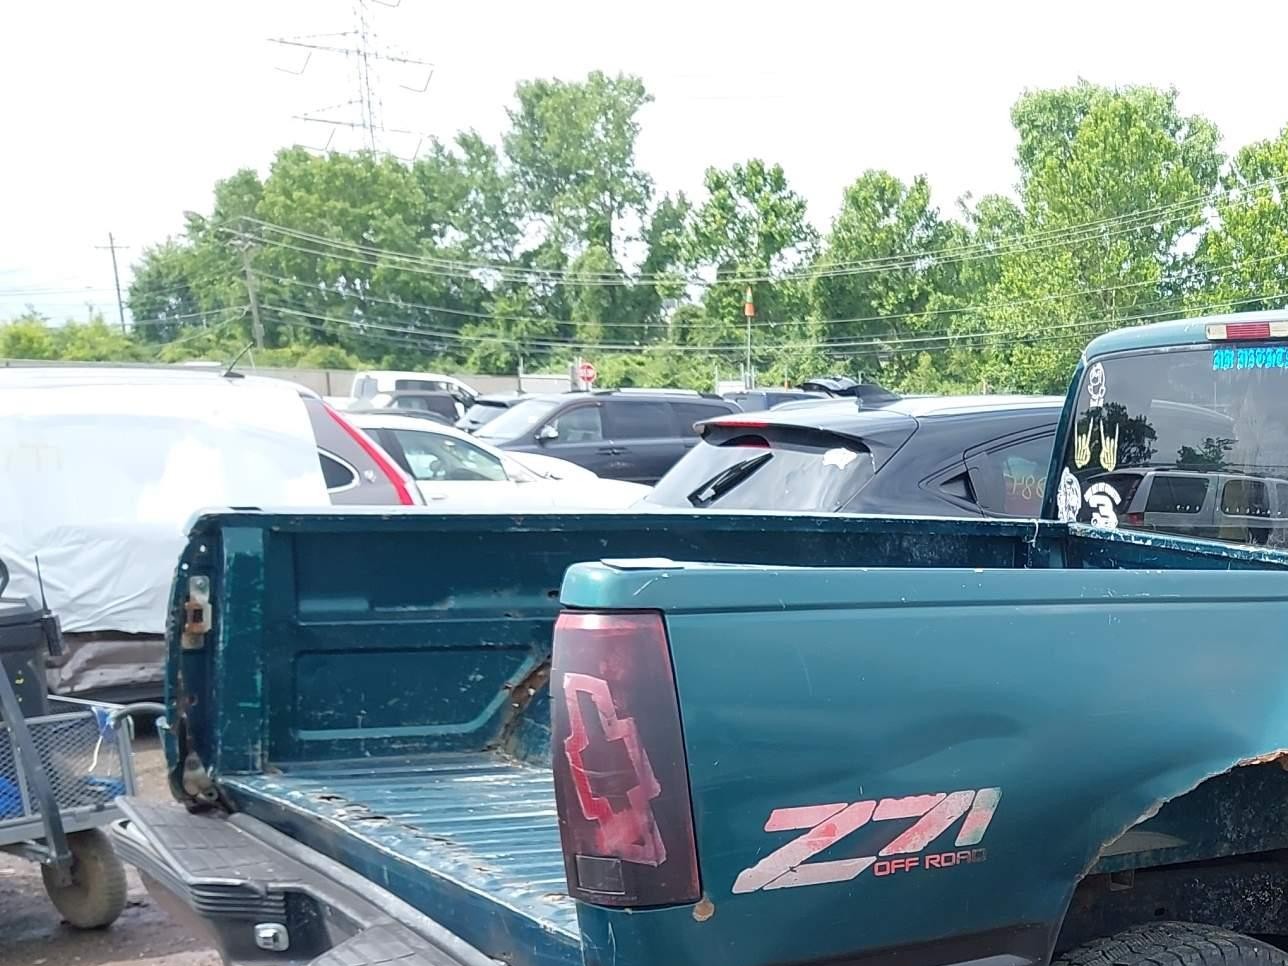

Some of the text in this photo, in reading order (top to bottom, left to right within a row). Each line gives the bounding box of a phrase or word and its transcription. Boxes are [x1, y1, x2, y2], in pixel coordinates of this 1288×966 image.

[731, 786, 1003, 894] Z71
[873, 848, 986, 877] OFF ROAD
